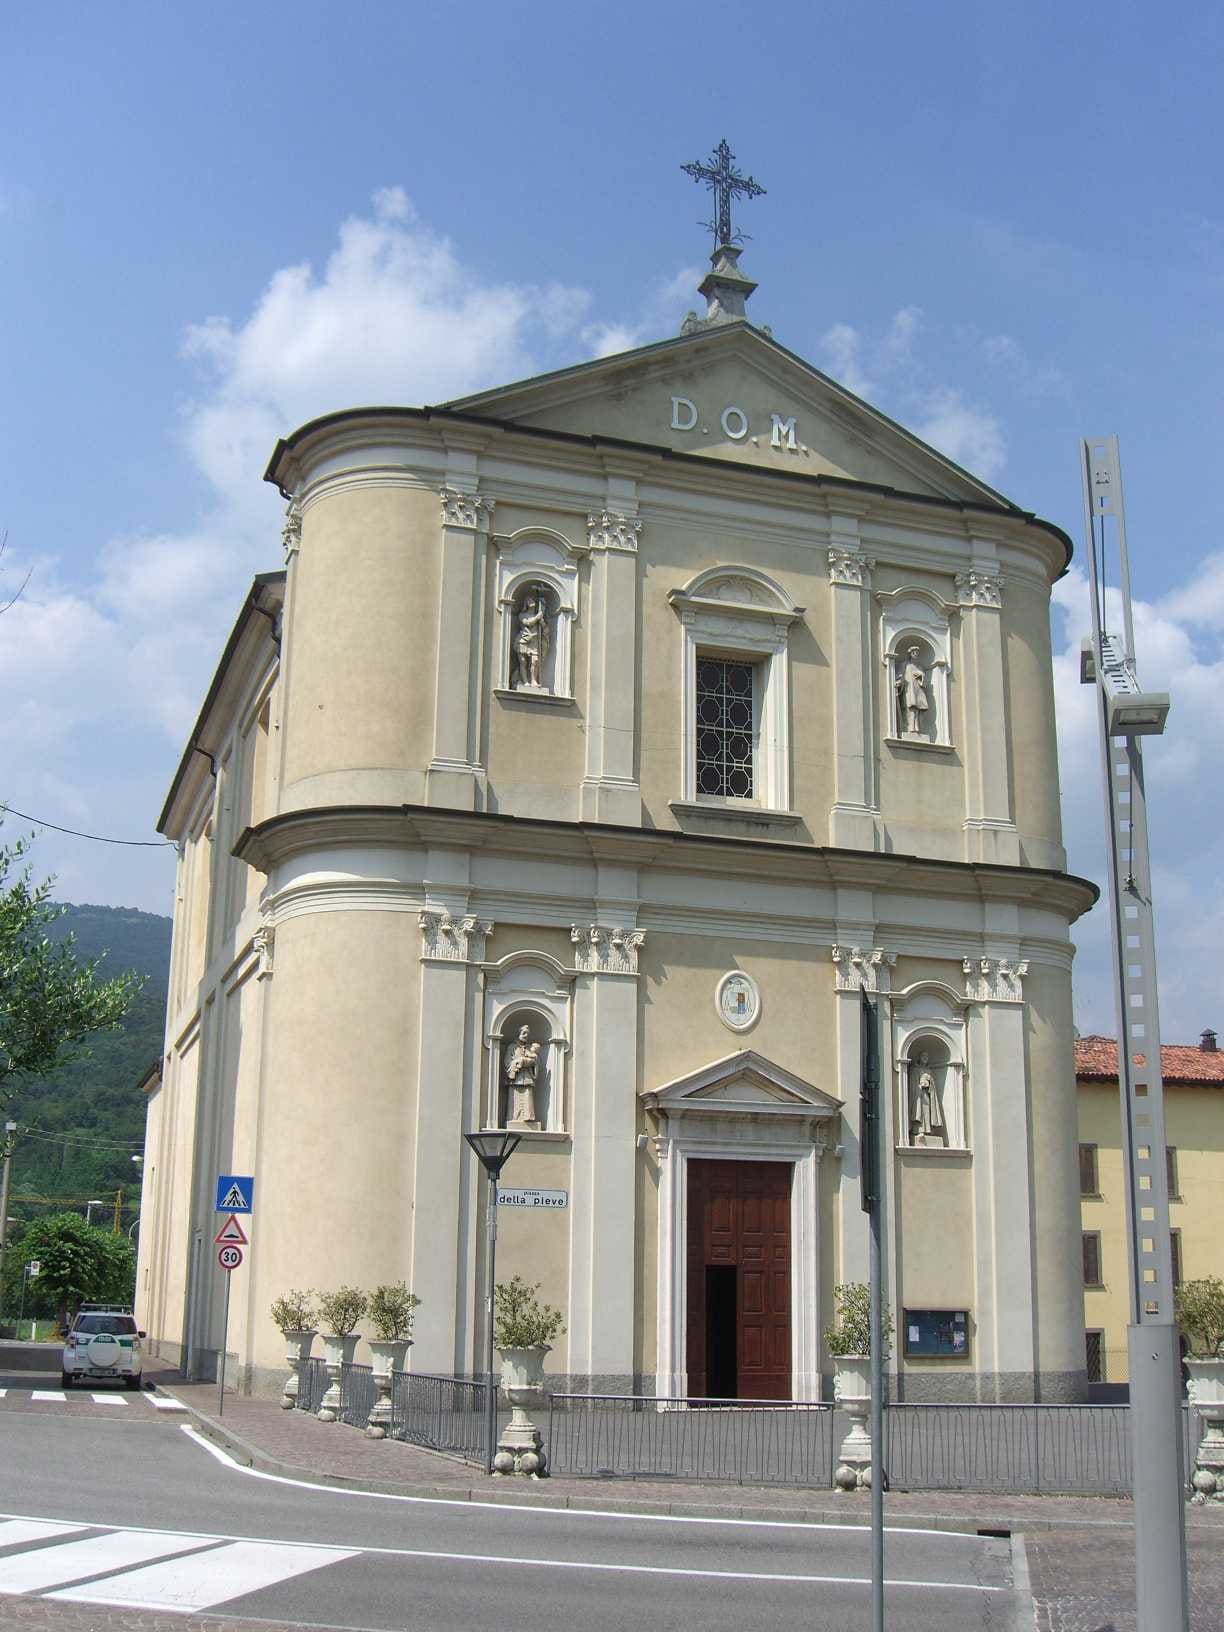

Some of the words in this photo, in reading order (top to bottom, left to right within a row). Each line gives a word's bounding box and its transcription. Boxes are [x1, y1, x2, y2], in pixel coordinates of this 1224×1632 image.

[499, 1195, 526, 1204] della
[534, 1196, 564, 1205] pieve
[223, 1251, 238, 1263] 30
